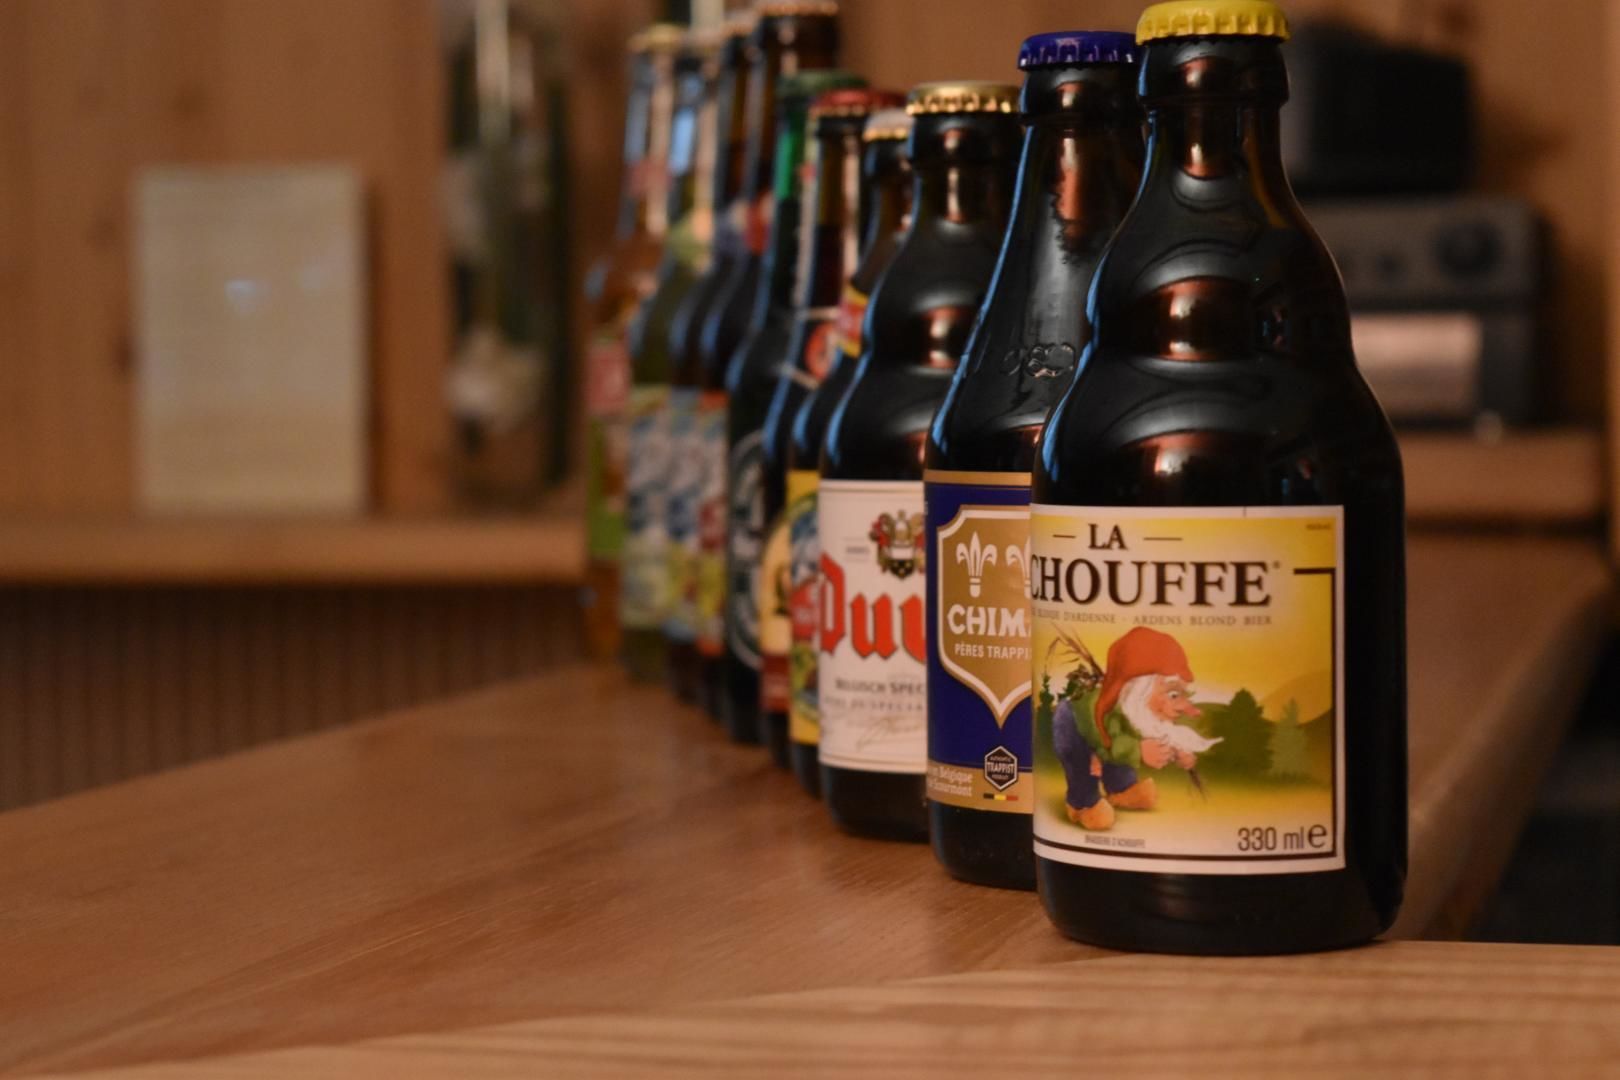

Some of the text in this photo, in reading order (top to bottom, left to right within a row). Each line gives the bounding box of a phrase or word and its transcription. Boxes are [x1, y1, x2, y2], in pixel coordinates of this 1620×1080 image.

[1087, 522, 1129, 551] LA
[1031, 553, 1272, 606] CHOUFFE
[947, 603, 1031, 638] CHIM
[1133, 614, 1182, 626] ARDENS
[1190, 615, 1236, 626] BLOND
[1244, 615, 1272, 626] BIER
[987, 645, 1031, 660] TRAPPI
[986, 761, 1015, 774] TRAPPIST
[1238, 827, 1277, 851] 330
[1283, 826, 1304, 850] ml
